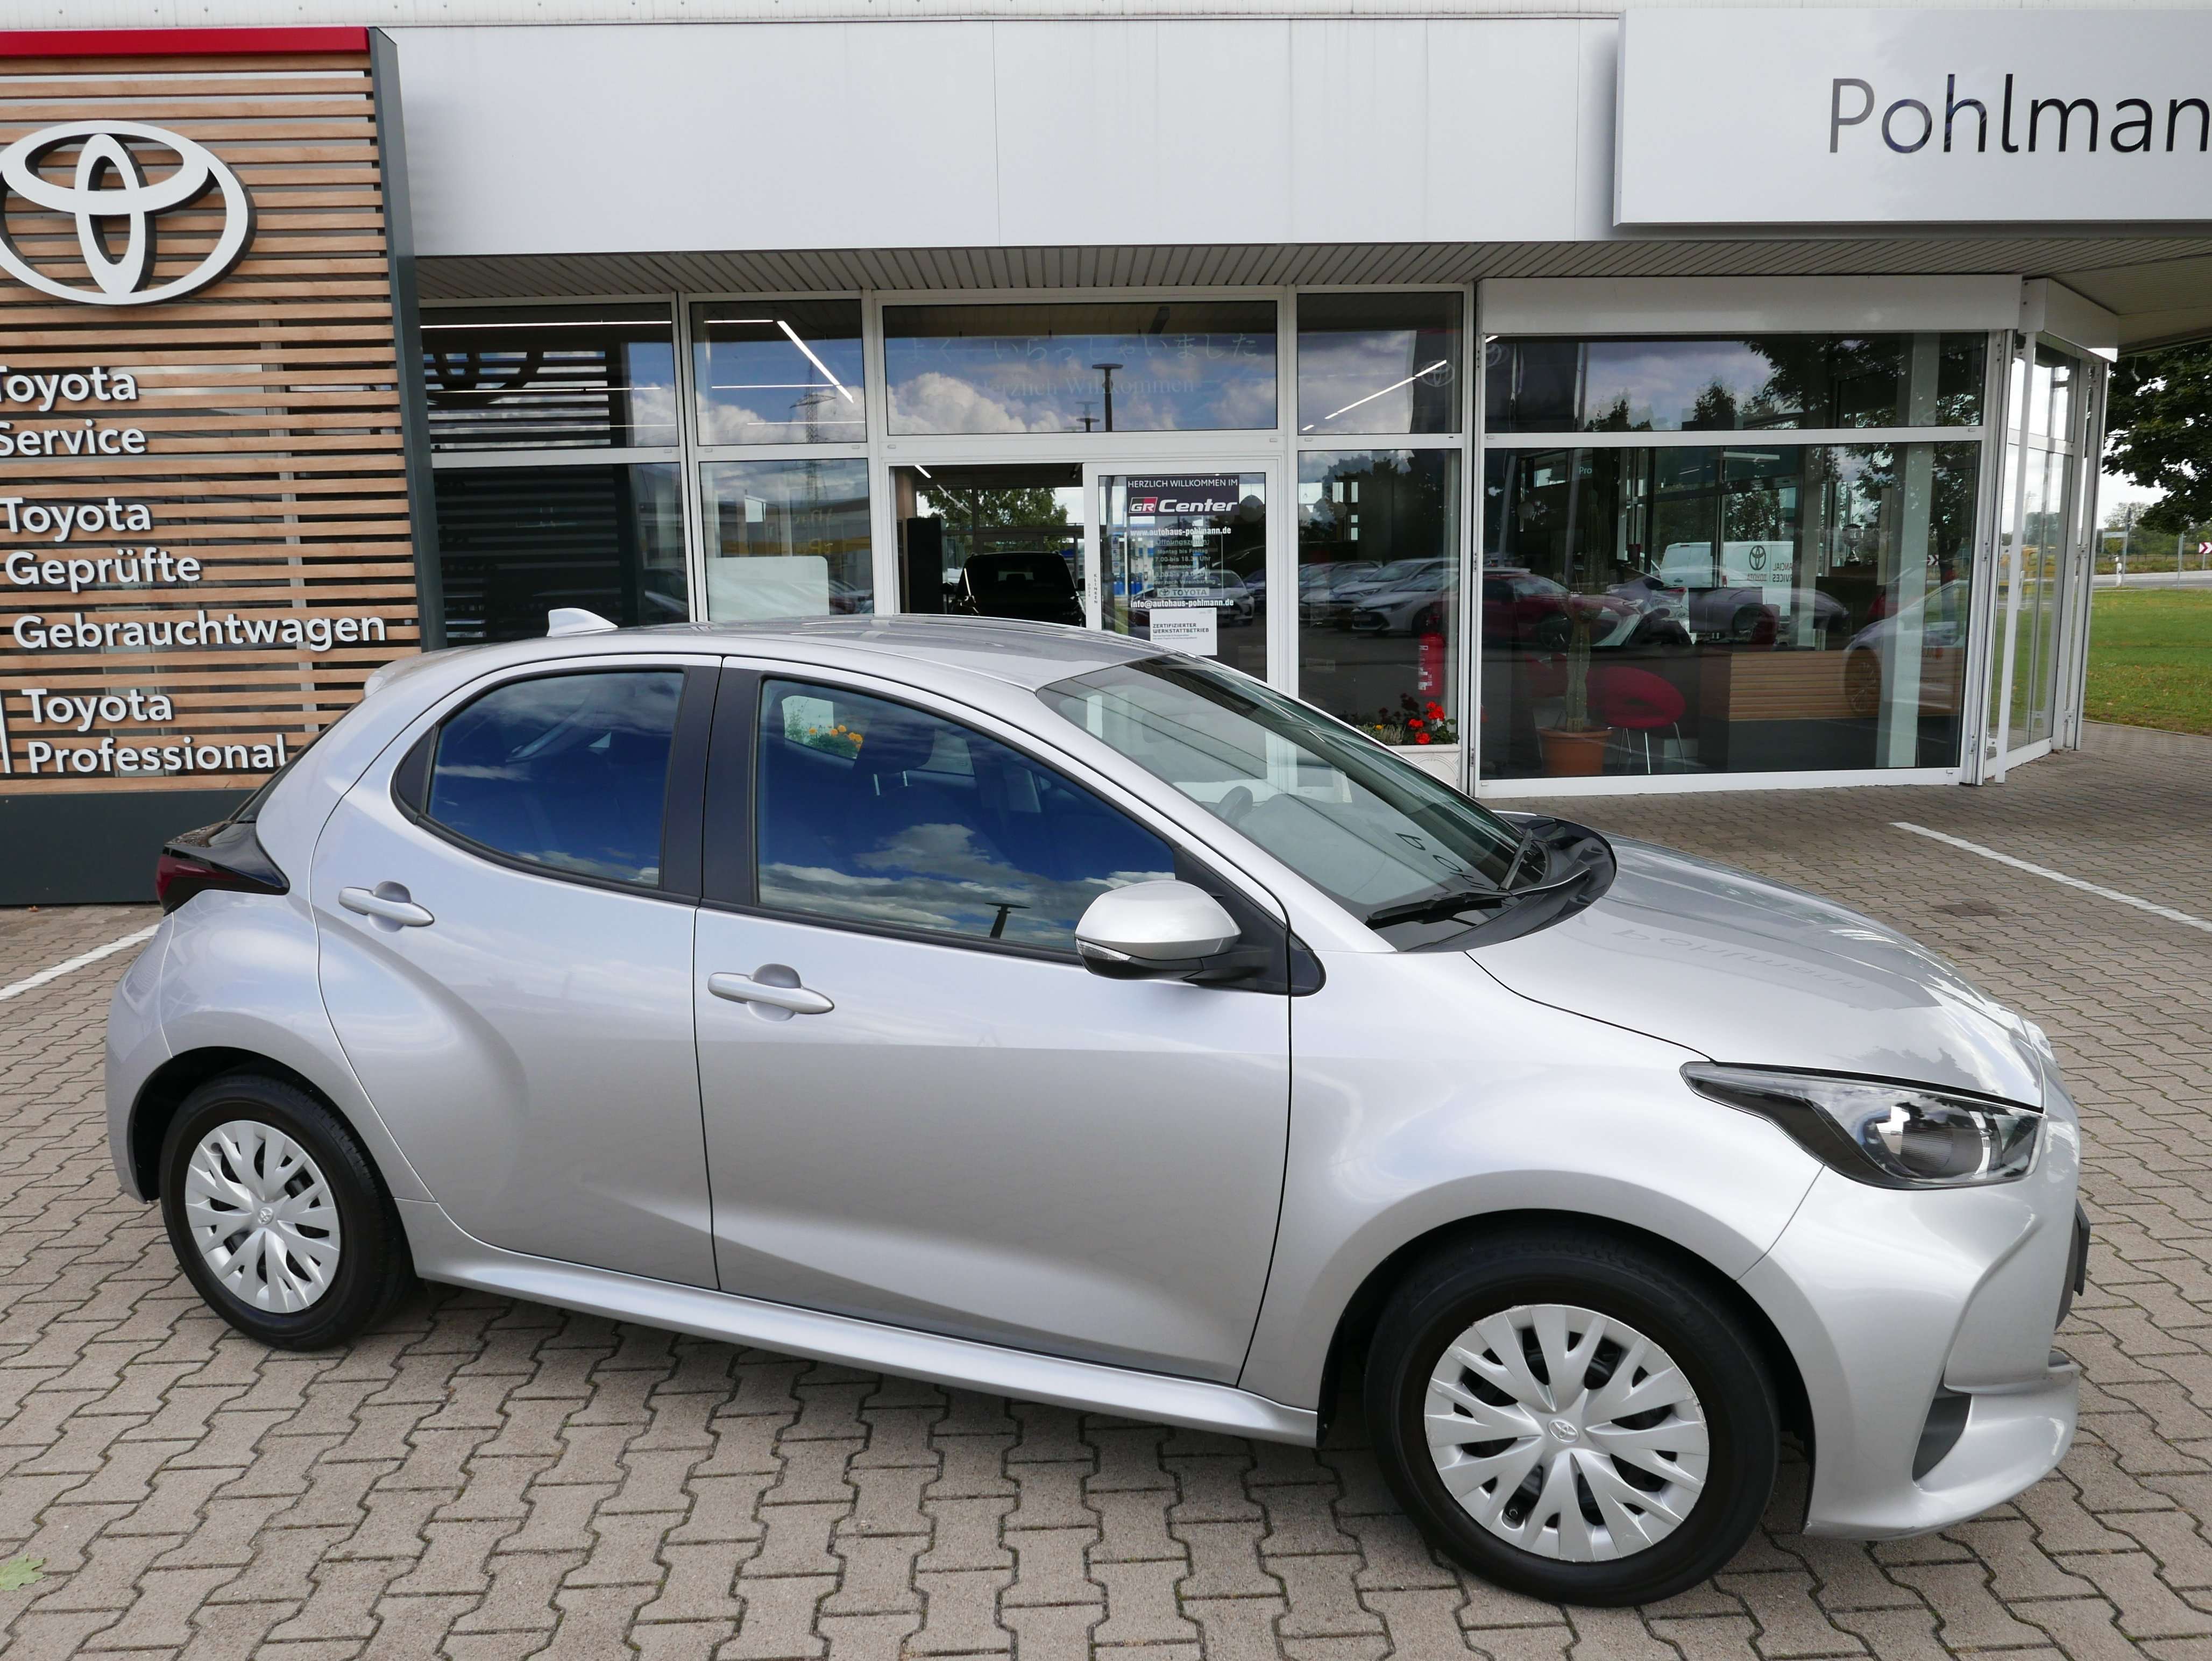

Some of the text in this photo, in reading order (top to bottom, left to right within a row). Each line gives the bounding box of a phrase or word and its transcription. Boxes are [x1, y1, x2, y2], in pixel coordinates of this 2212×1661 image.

[1829, 74, 2210, 154] Pohlman
[0, 418, 146, 457] Service
[1128, 478, 1238, 488] HERZLICH WILLKOMMEN IM
[1, 497, 152, 543] Toyota
[1131, 498, 1238, 513] GR Center
[5, 546, 201, 593] Geprüfte
[1130, 598, 1234, 609] info@autohaus-pohlmann.de
[13, 609, 386, 651] Gebrauchtwagen
[22, 688, 173, 732] Toyota
[28, 734, 289, 774] Professional
